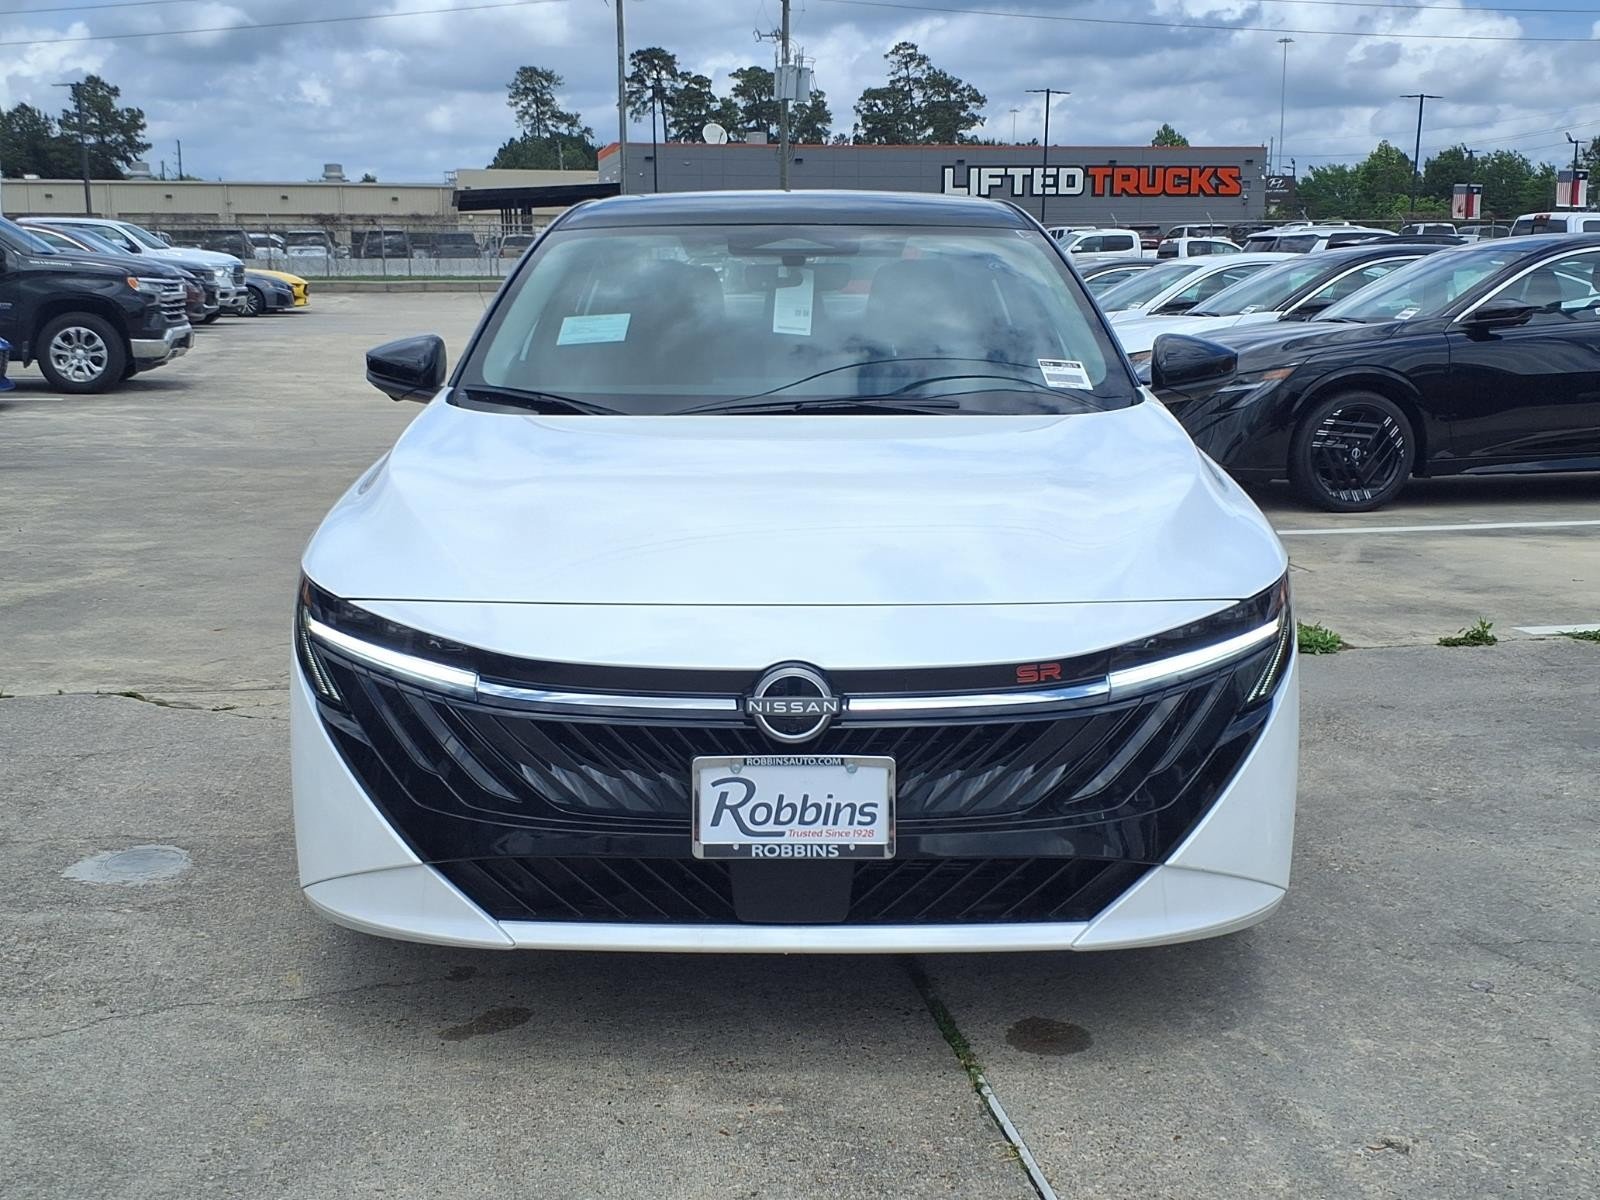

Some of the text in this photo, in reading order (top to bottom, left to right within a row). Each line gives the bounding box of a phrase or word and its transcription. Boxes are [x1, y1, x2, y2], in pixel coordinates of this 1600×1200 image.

[943, 167, 1241, 196] LIFTED TRUCKS
[1016, 663, 1061, 683] SR
[748, 701, 838, 713] NISSAN
[746, 757, 842, 766] ROBBINSAUTO.COM
[710, 777, 878, 837] Robbins
[788, 829, 874, 838] Trusted Since 1928
[751, 844, 839, 857] ROBBINS
